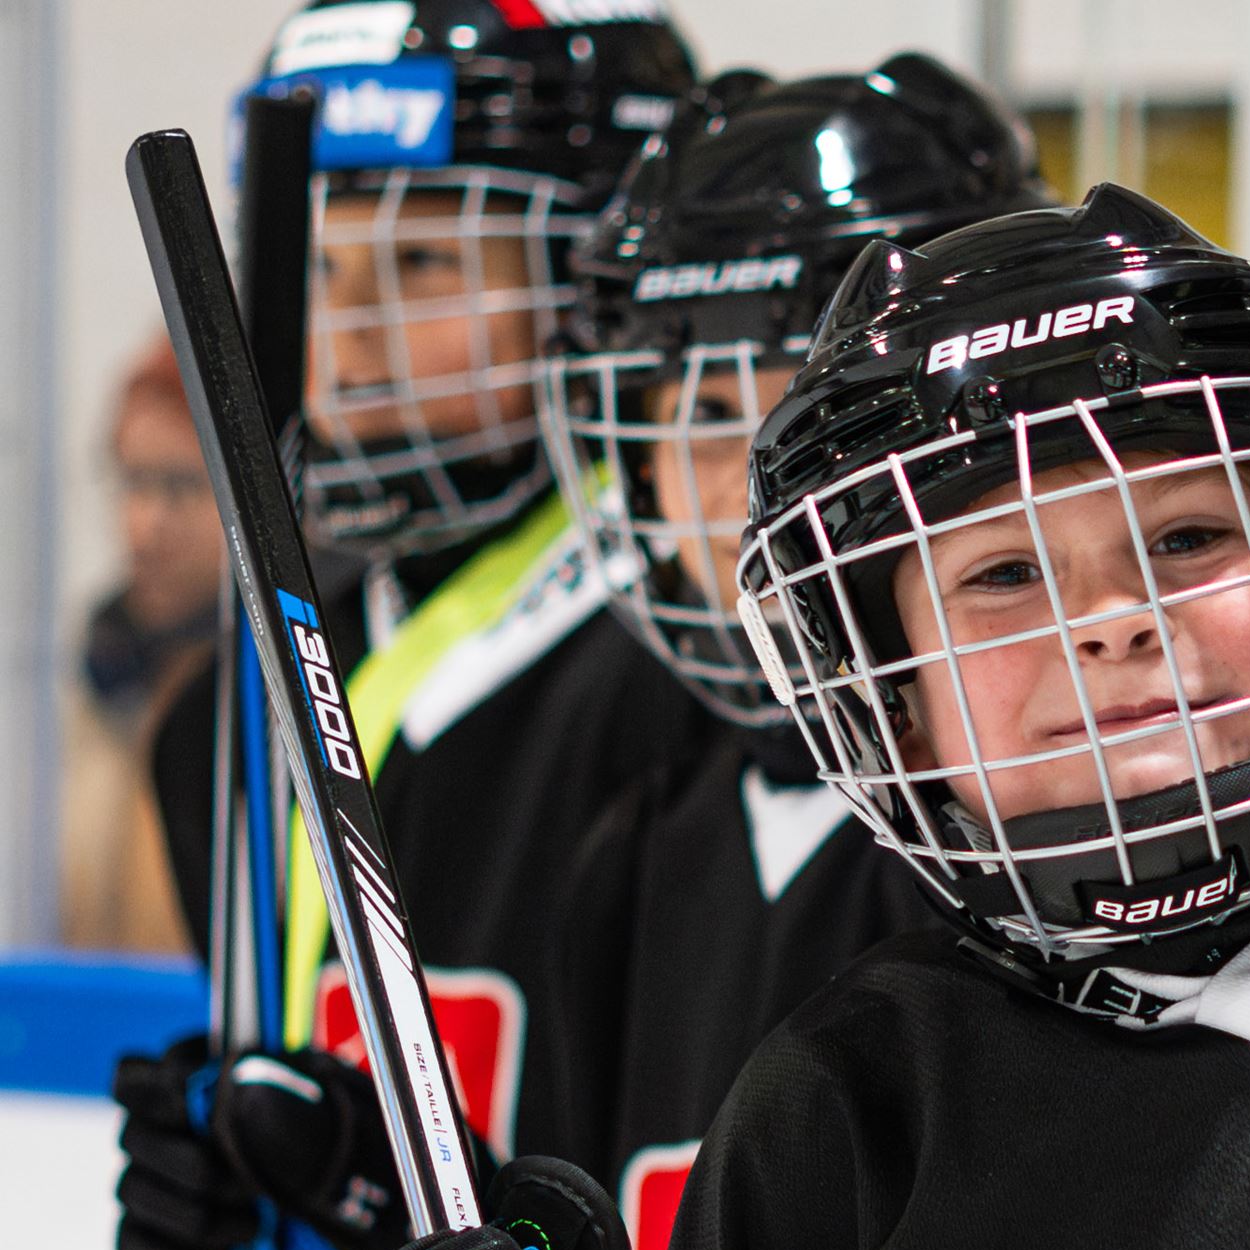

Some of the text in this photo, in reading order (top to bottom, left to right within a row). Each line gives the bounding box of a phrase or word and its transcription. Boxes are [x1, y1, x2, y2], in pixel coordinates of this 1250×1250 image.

[294, 624, 361, 780] 3000
[436, 1137, 452, 1163] JR
[452, 1187, 467, 1222] FLEX
